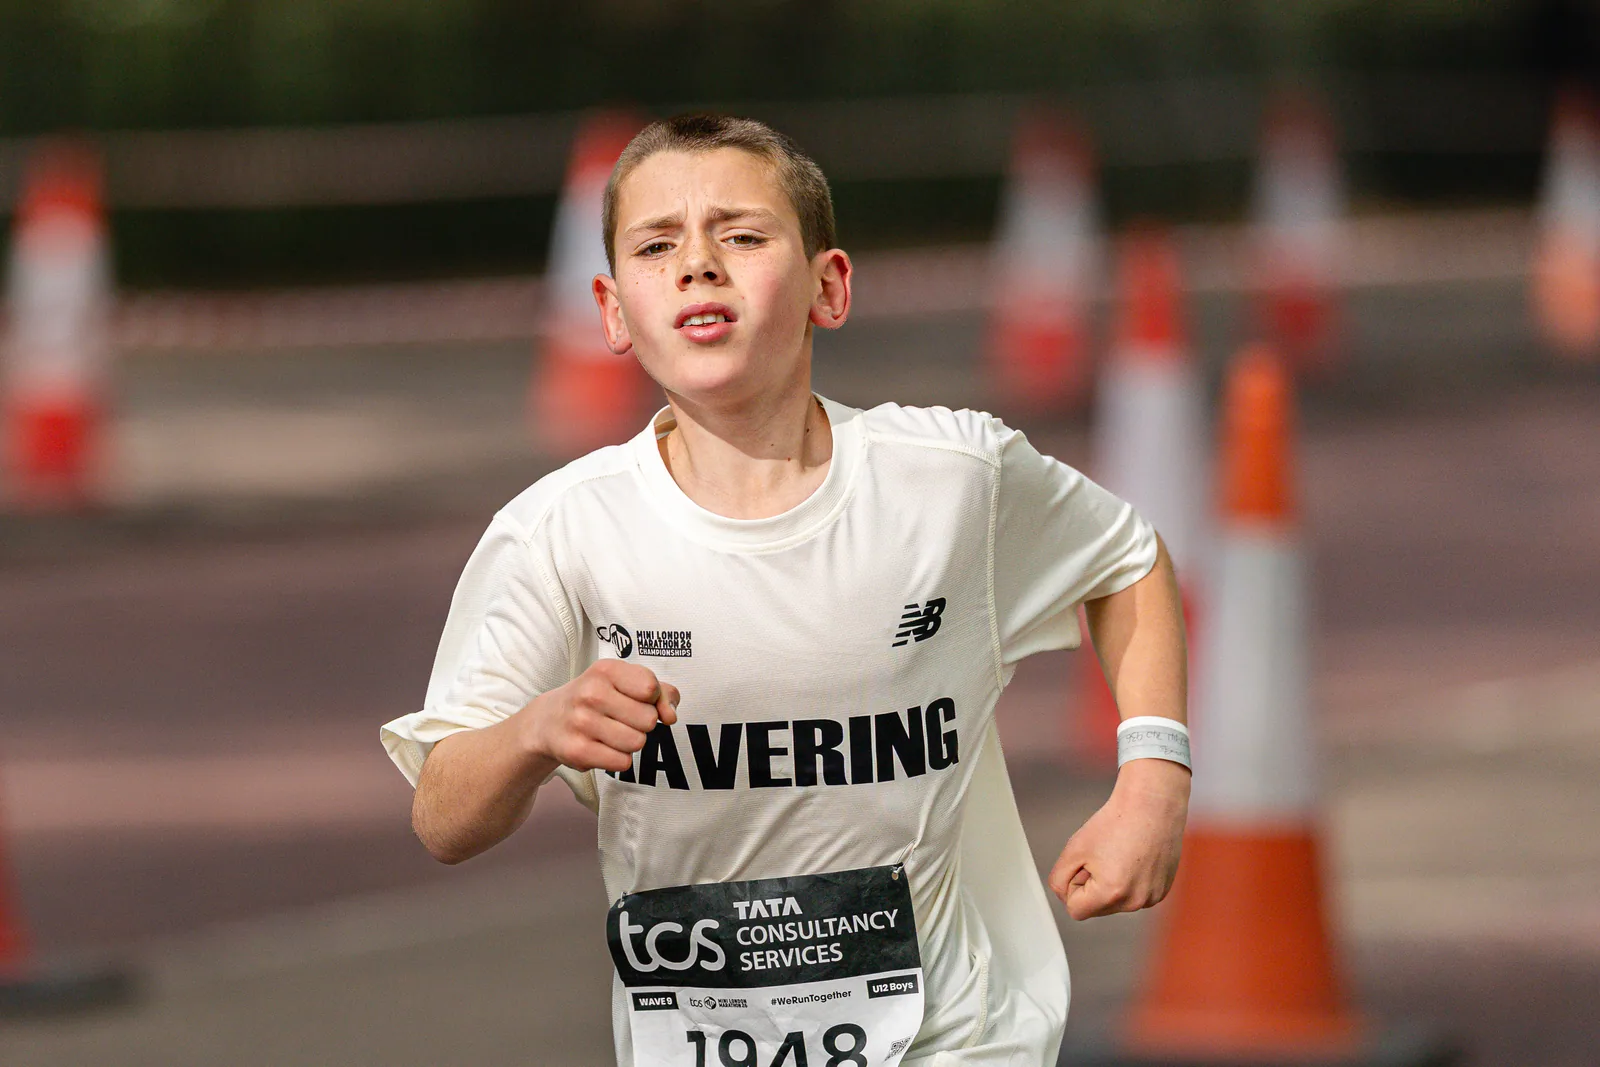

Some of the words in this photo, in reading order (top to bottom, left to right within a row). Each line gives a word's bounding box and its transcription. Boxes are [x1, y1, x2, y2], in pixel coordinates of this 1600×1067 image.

[637, 631, 654, 640] MINI
[657, 631, 691, 640] LONDON
[638, 639, 679, 648] MARATHON
[681, 640, 691, 648] 26
[639, 648, 691, 656] CHAMPIONSHIPS
[605, 697, 960, 790] AVERING
[733, 897, 803, 920] TATA
[736, 909, 899, 945] CONSULTANCY
[619, 910, 726, 972] tcs
[739, 943, 843, 971] SERVICES
[872, 983, 889, 993] U12
[889, 981, 914, 993] Boys
[639, 997, 666, 1006] WAVE
[666, 997, 673, 1005] 9
[689, 997, 703, 1008] tcs
[770, 990, 852, 1006] #WeRunTogether
[686, 1023, 868, 1067] 1948
